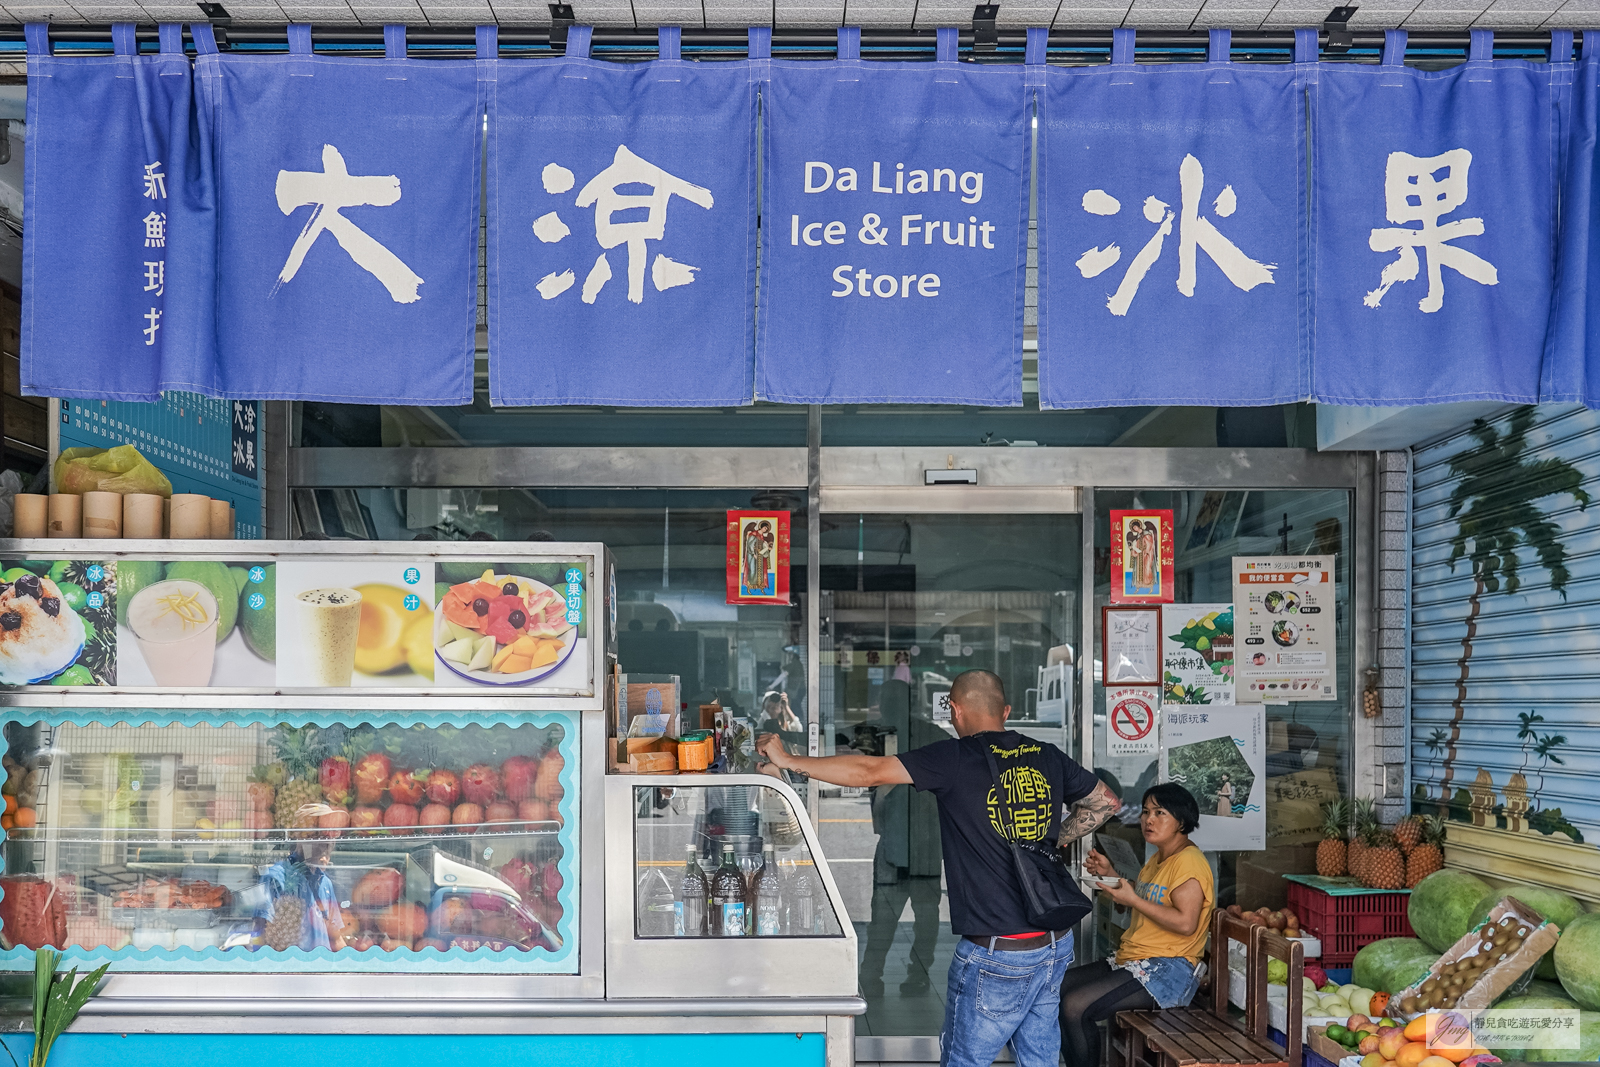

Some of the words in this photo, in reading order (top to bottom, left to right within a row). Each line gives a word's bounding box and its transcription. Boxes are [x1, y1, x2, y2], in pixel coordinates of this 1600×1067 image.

[804, 161, 858, 194] Da
[872, 161, 984, 204] Liang
[791, 214, 847, 247] Ice
[857, 212, 889, 246] &
[901, 213, 996, 250] Fruit
[831, 264, 941, 298] Store
[76, 418, 81, 428] 70
[84, 422, 90, 431] 70
[93, 412, 98, 421] 70
[88, 567, 103, 608] 冰品
[250, 568, 264, 608] 冰沙
[405, 568, 419, 610] 果汁
[567, 570, 581, 624] 水果切盤
